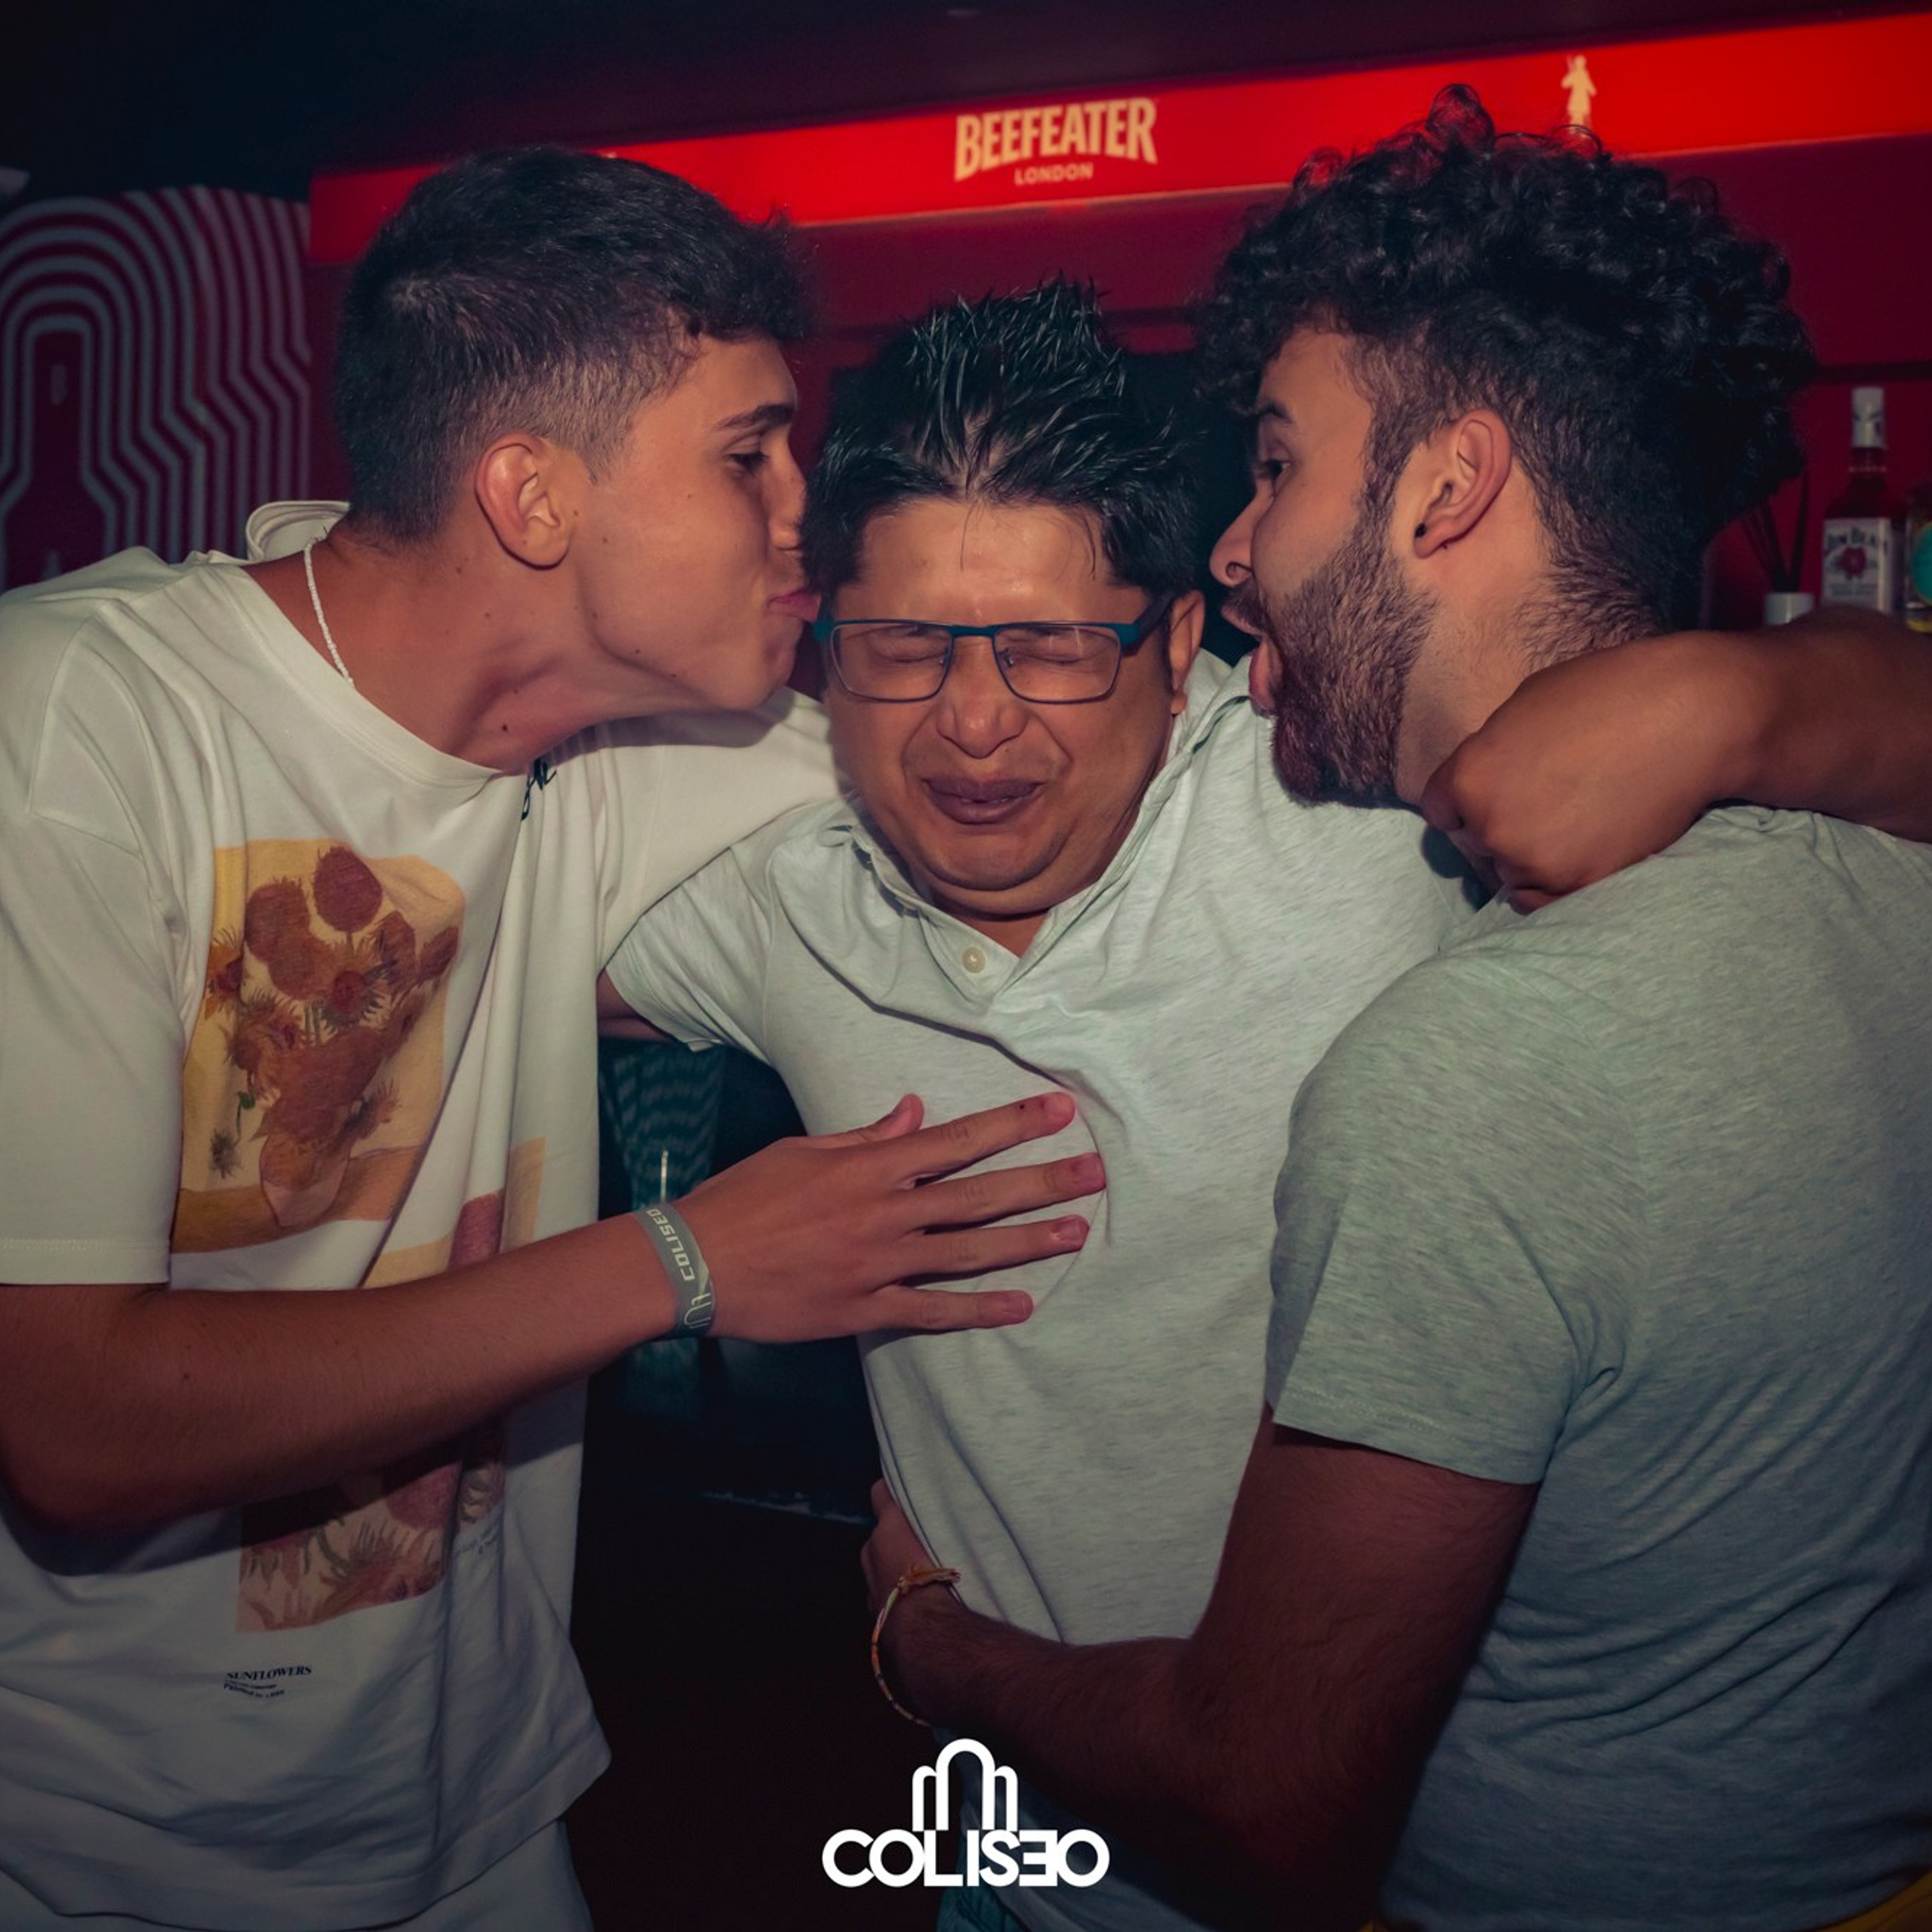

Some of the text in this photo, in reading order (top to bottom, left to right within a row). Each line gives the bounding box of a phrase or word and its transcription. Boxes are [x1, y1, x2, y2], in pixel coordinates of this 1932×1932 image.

[955, 97, 1158, 182] BEEFEATER
[1014, 162, 1094, 186] LONDON
[646, 1208, 696, 1281] COLISEO
[226, 1665, 312, 1681] SUNFLOWERS
